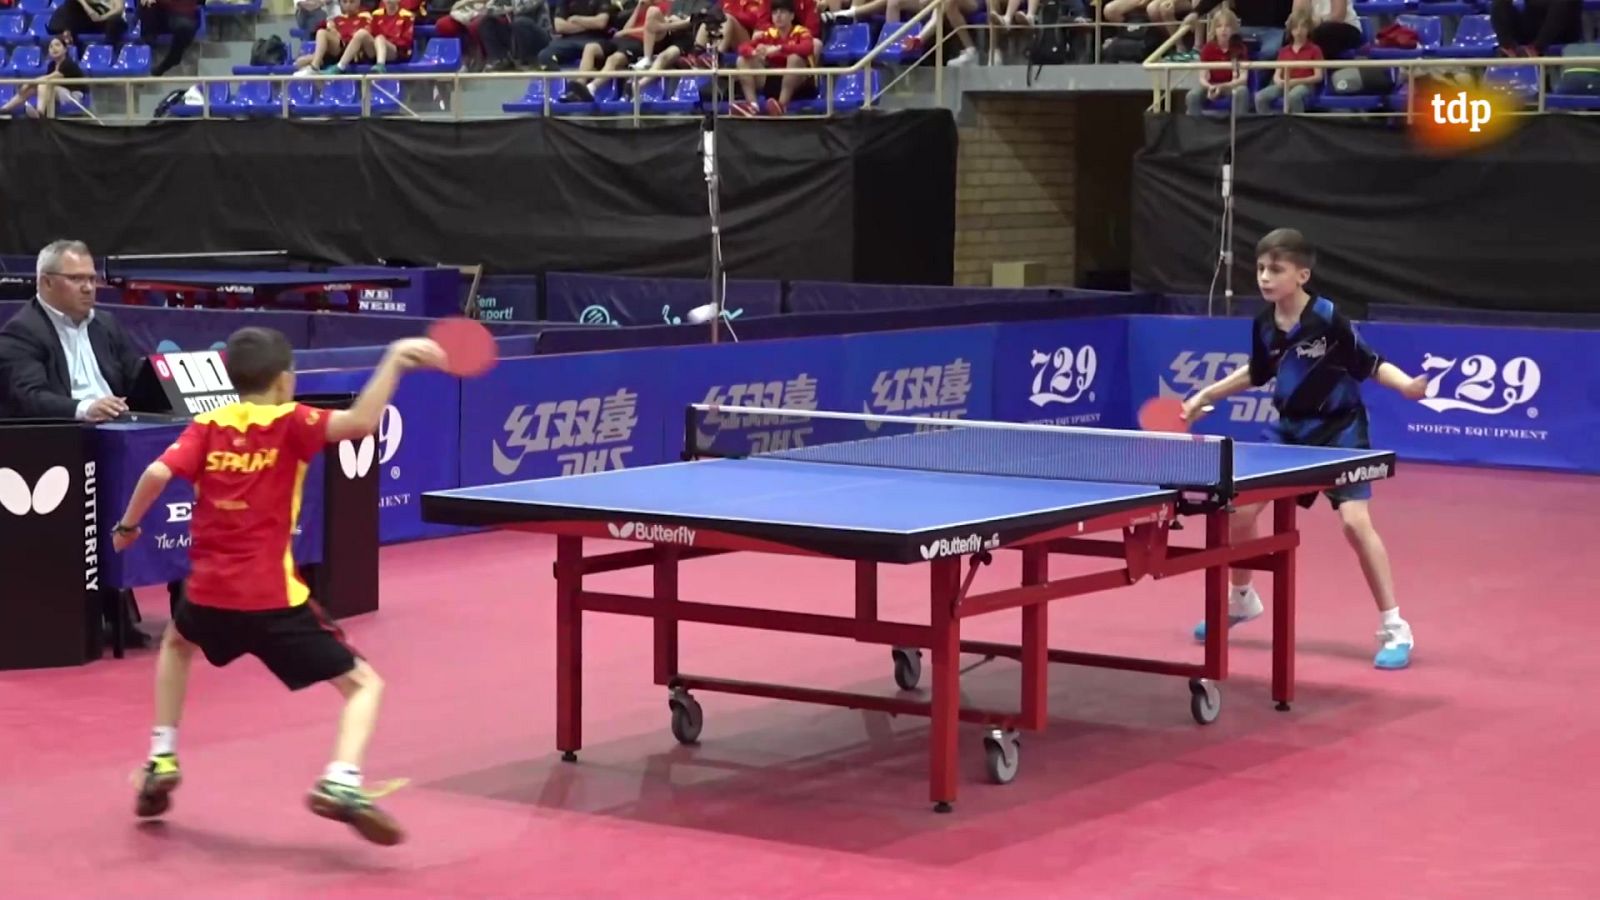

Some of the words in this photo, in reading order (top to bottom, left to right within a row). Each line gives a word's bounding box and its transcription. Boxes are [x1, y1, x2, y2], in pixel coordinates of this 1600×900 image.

[359, 301, 406, 311] NEBE
[477, 295, 496, 307] em
[871, 358, 972, 412] 红双喜
[1029, 345, 1097, 407] 729
[1418, 353, 1541, 414] 729
[702, 373, 818, 429] 红双喜
[1226, 395, 1281, 422] DH
[503, 387, 638, 452] 红双喜
[1407, 423, 1461, 434] SPORTS
[1464, 426, 1548, 440] EQUIPMENT
[84, 460, 99, 591] BUTTERFLY
[635, 521, 696, 547] Butterfly
[155, 533, 175, 549] The
[940, 533, 982, 557] Butterfly
